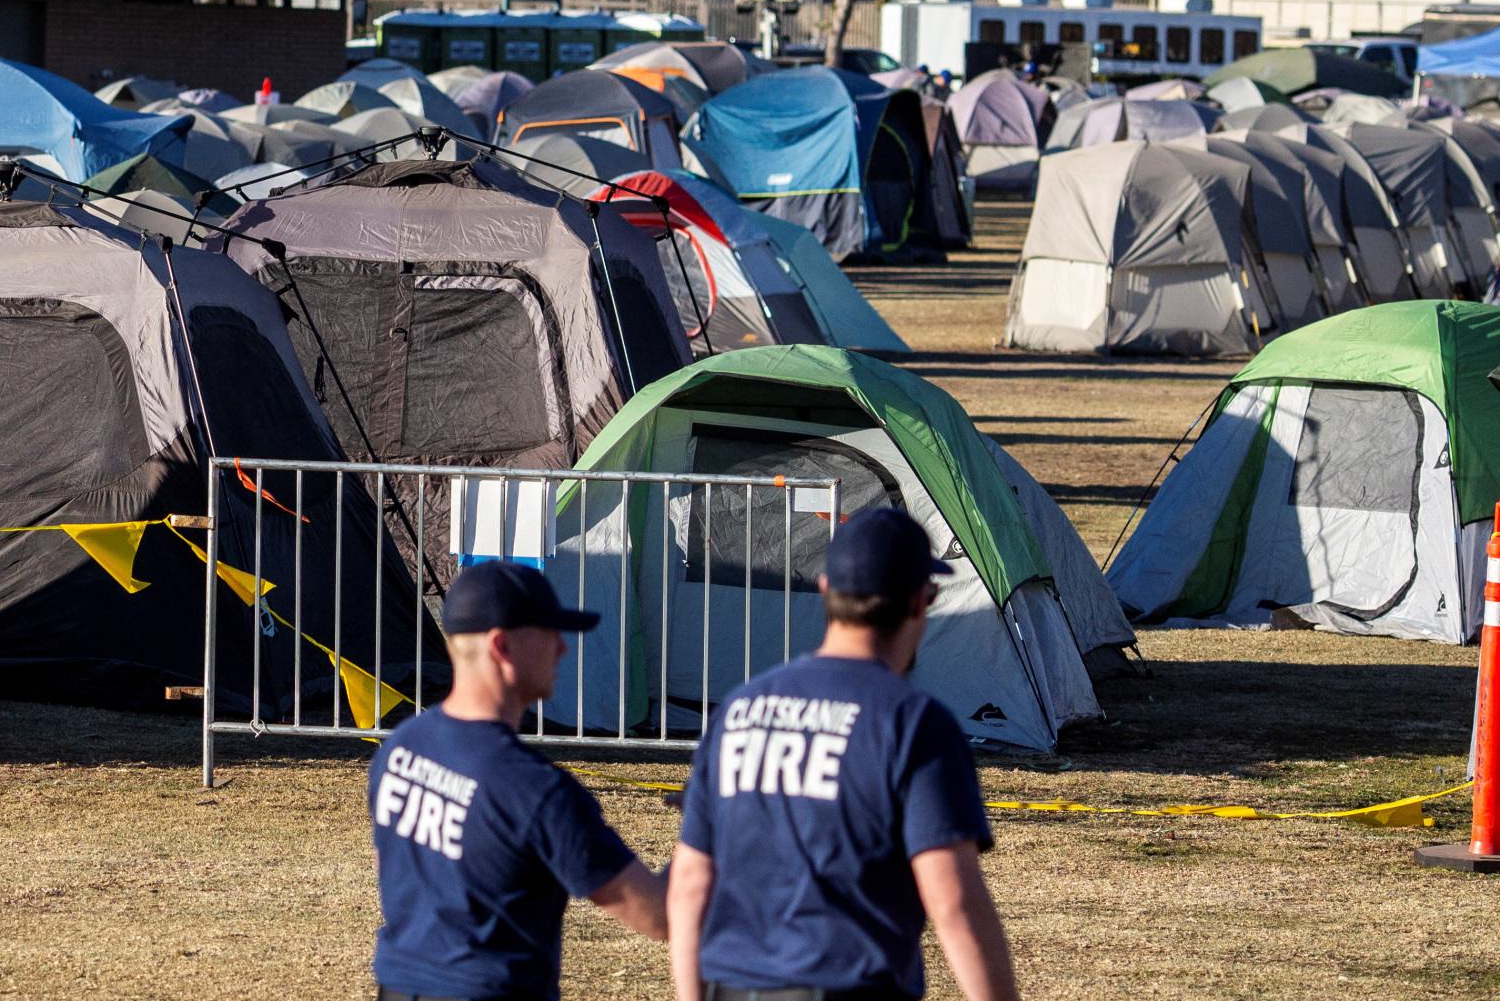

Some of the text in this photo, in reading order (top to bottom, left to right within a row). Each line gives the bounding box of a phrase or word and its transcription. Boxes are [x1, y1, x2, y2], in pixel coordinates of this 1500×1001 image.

[724, 694, 861, 737] CLATSKANIE
[718, 728, 849, 802] FIRE
[375, 770, 468, 861] FIRE
